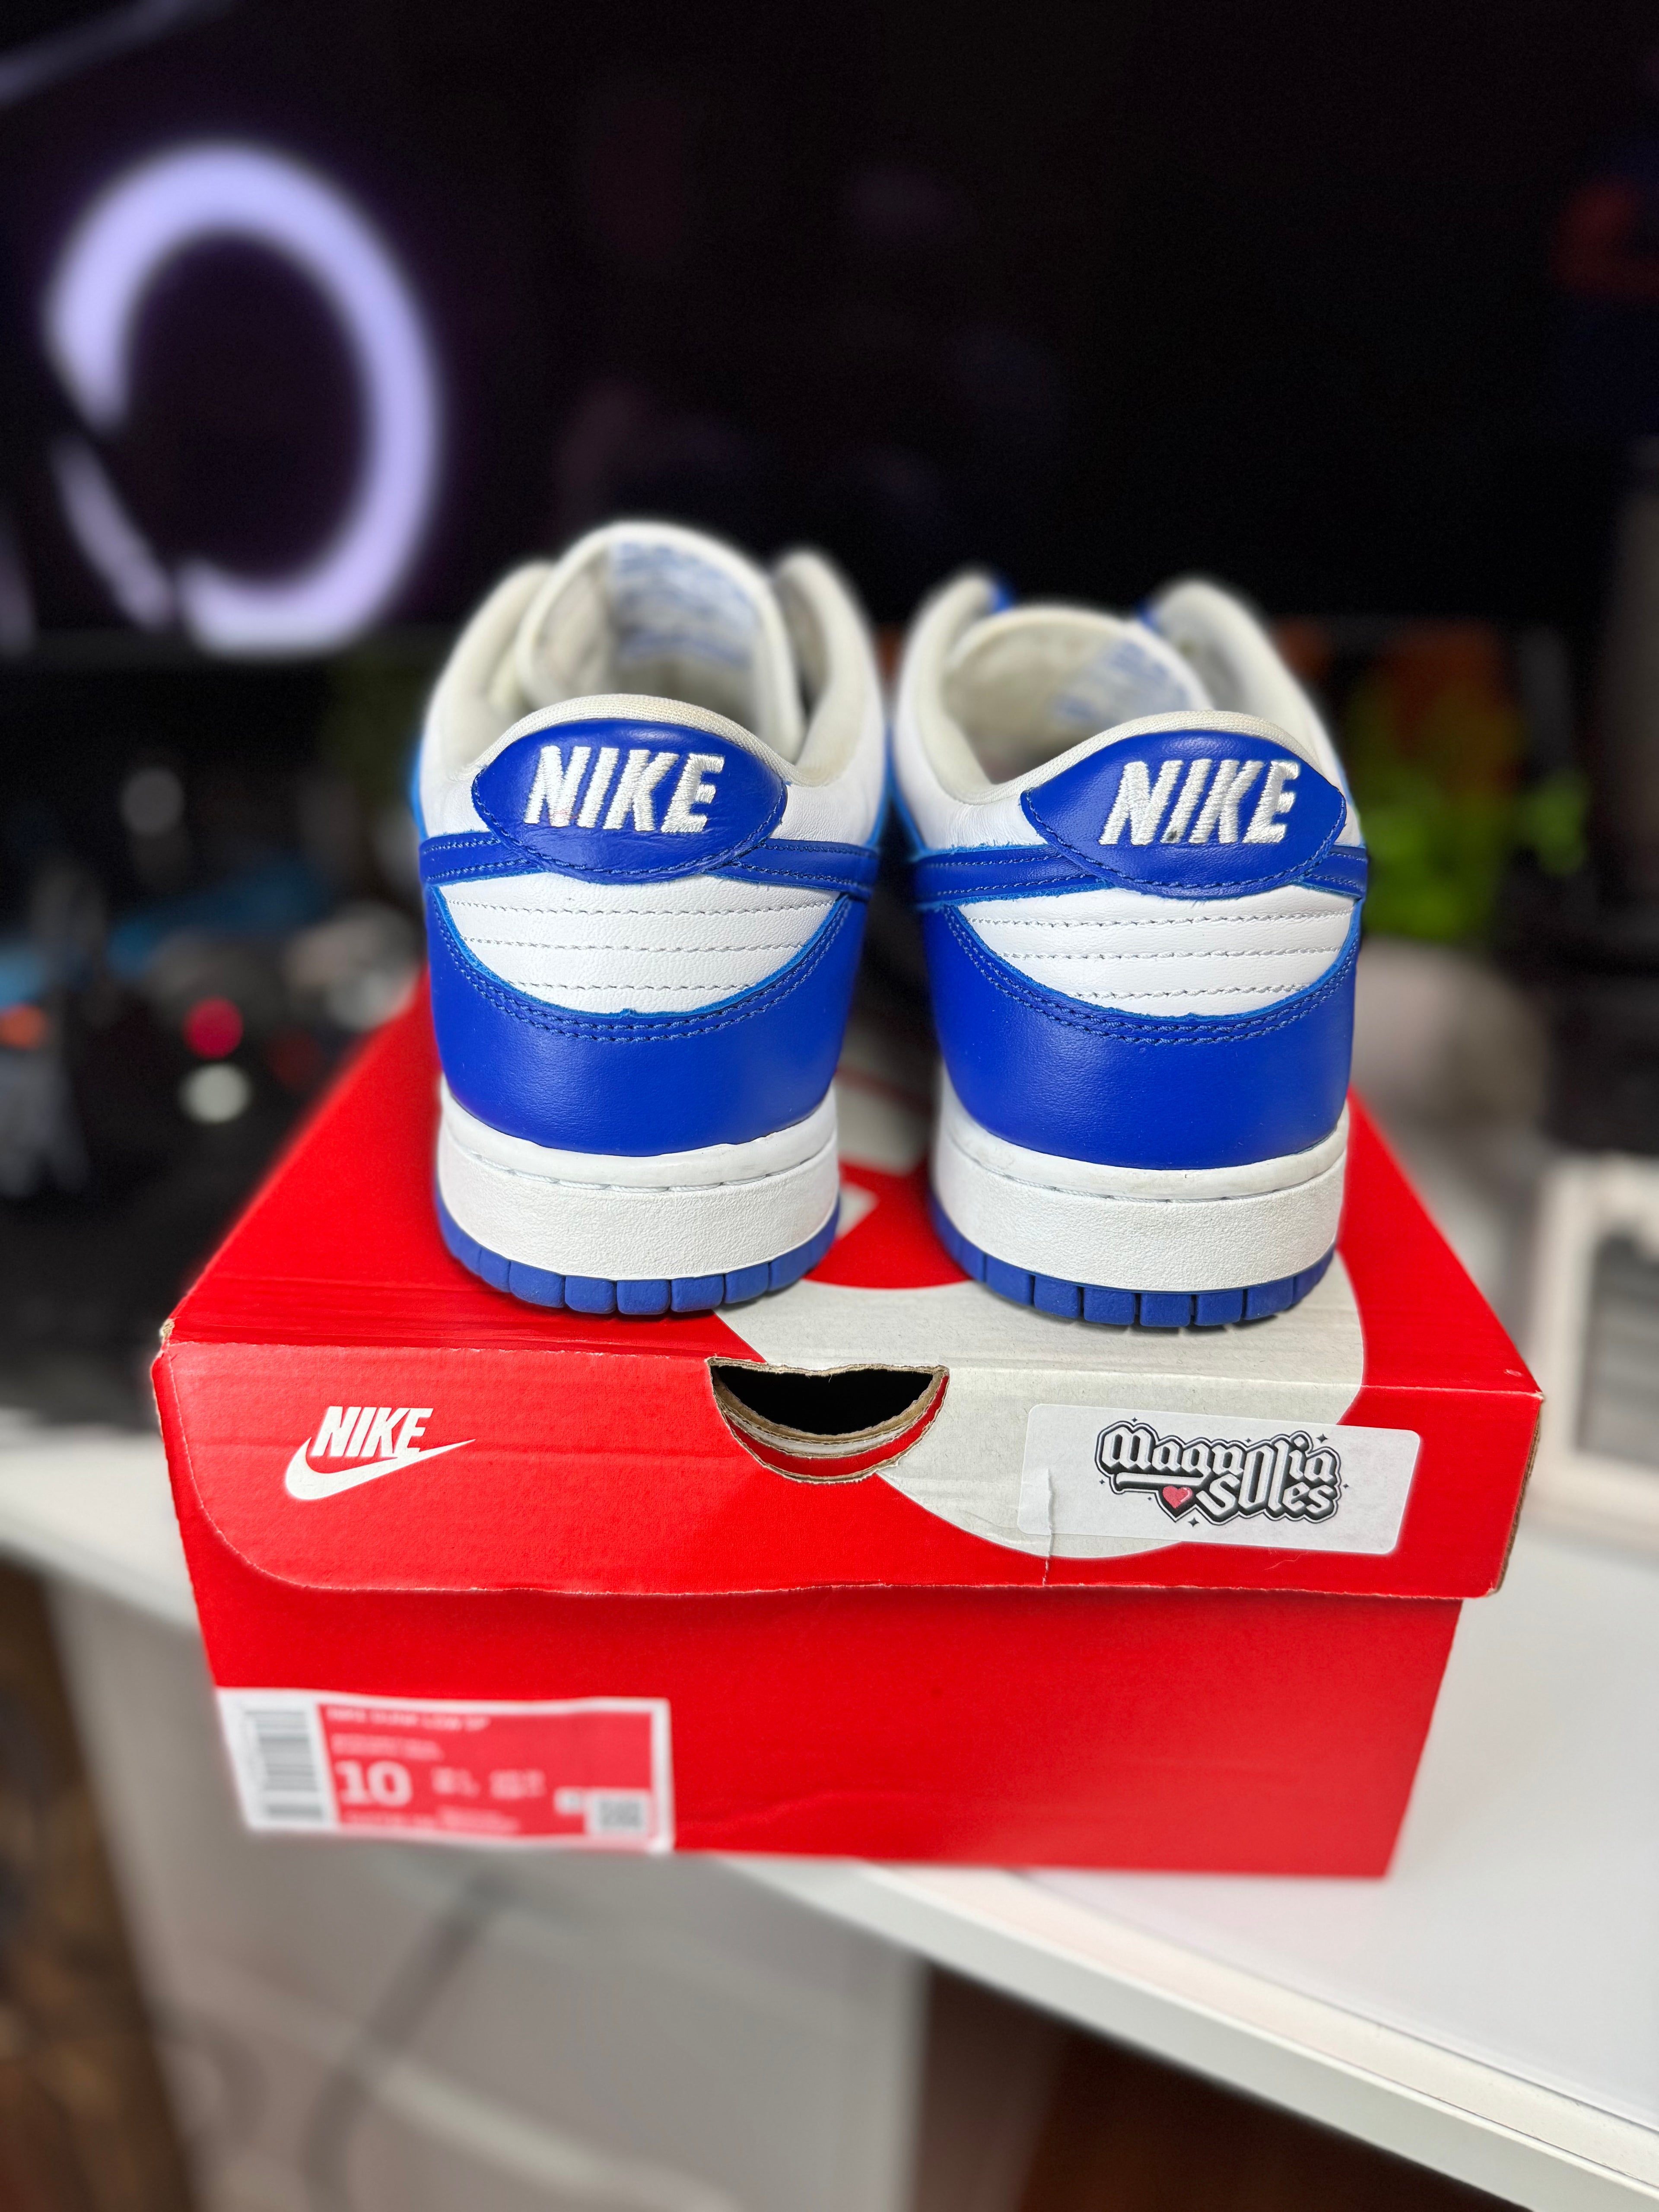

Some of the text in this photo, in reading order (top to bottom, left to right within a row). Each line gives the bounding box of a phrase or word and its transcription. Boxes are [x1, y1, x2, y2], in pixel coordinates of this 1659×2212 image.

[524, 745, 725, 833] NIKE
[1098, 759, 1300, 845] NIKE
[311, 1406, 434, 1458] NIKE
[334, 1760, 413, 1807] 10
